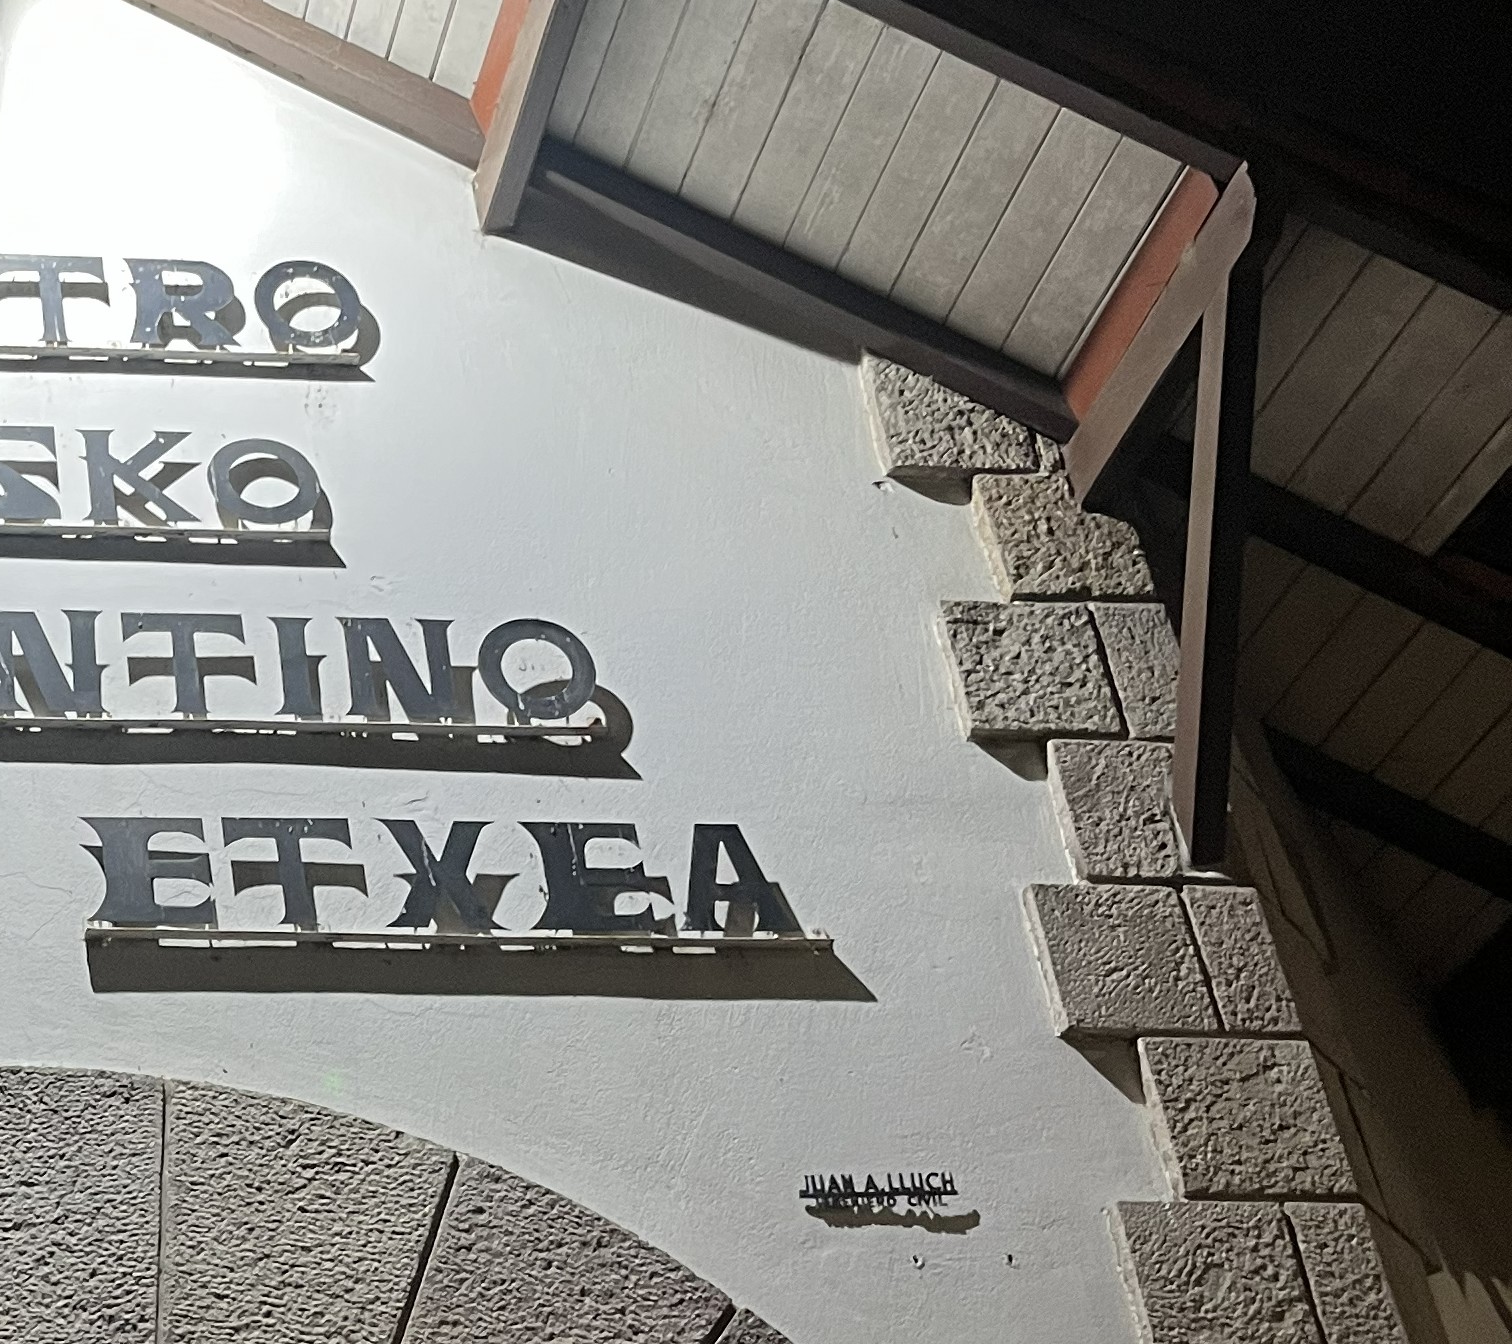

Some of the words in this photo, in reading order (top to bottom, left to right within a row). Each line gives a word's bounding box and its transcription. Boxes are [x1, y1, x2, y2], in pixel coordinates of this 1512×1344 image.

[81, 817, 802, 933] ETXEA
[804, 1173, 855, 1194] JUAN
[887, 1172, 956, 1193] LLUCH
